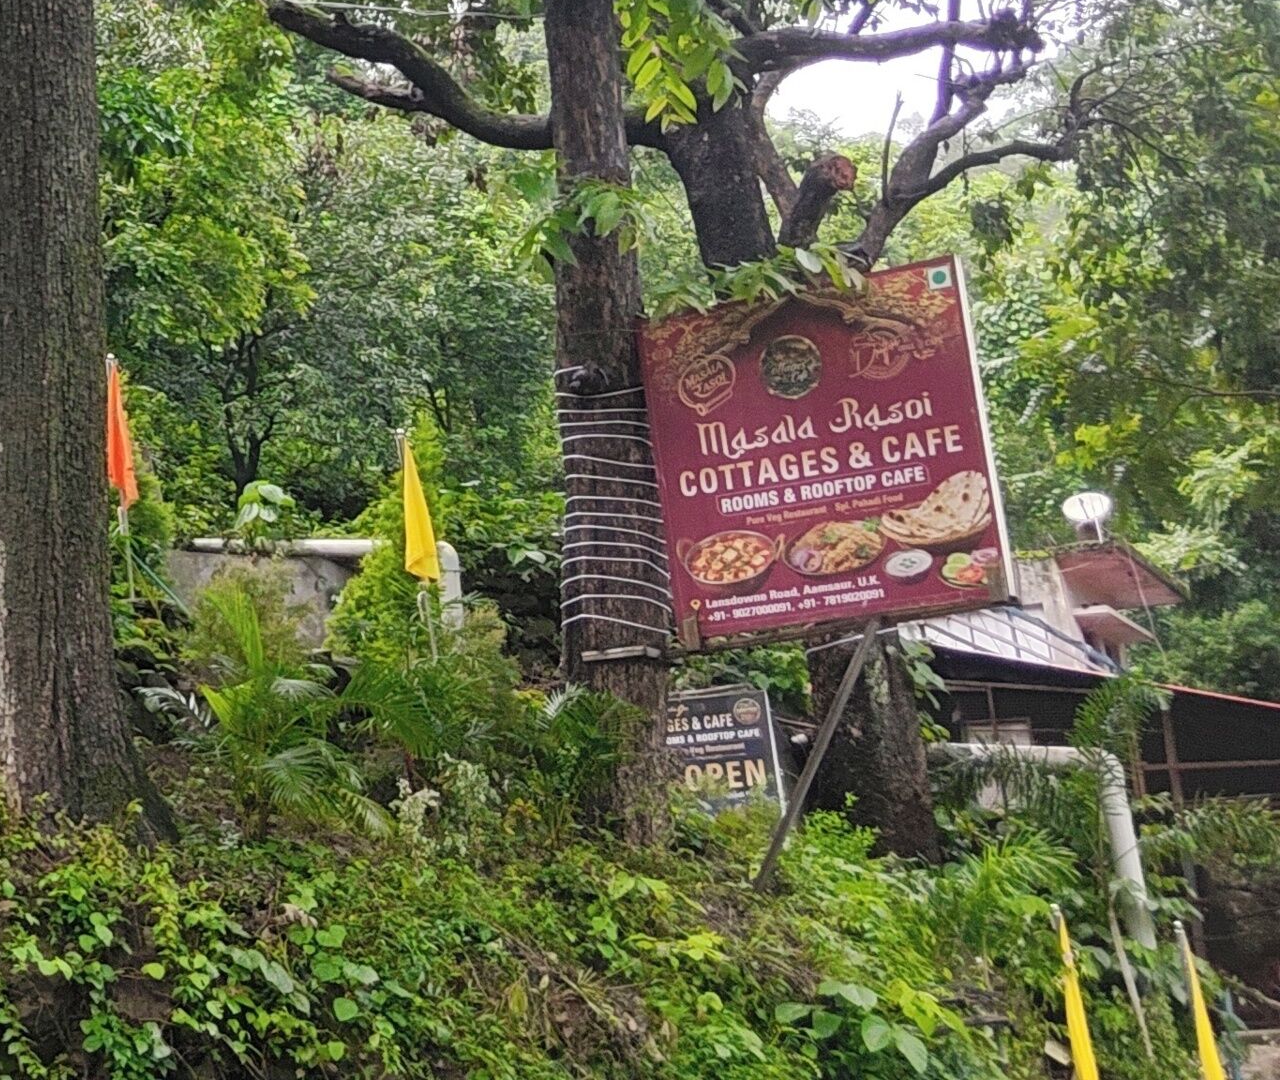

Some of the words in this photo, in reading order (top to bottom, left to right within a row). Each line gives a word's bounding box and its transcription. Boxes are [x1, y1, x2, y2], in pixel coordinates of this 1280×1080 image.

[695, 414, 818, 459] Masala
[829, 392, 933, 432] Rasoi
[679, 447, 839, 497] COTTAGES
[849, 442, 873, 469] &
[881, 425, 964, 463] CAFE
[721, 488, 779, 514] ROOMS
[783, 484, 797, 503] &
[801, 474, 877, 501] ROOFTOP
[881, 466, 926, 487] CAFE
[703, 713, 735, 729] CAFE
[684, 758, 768, 792] OPEN
